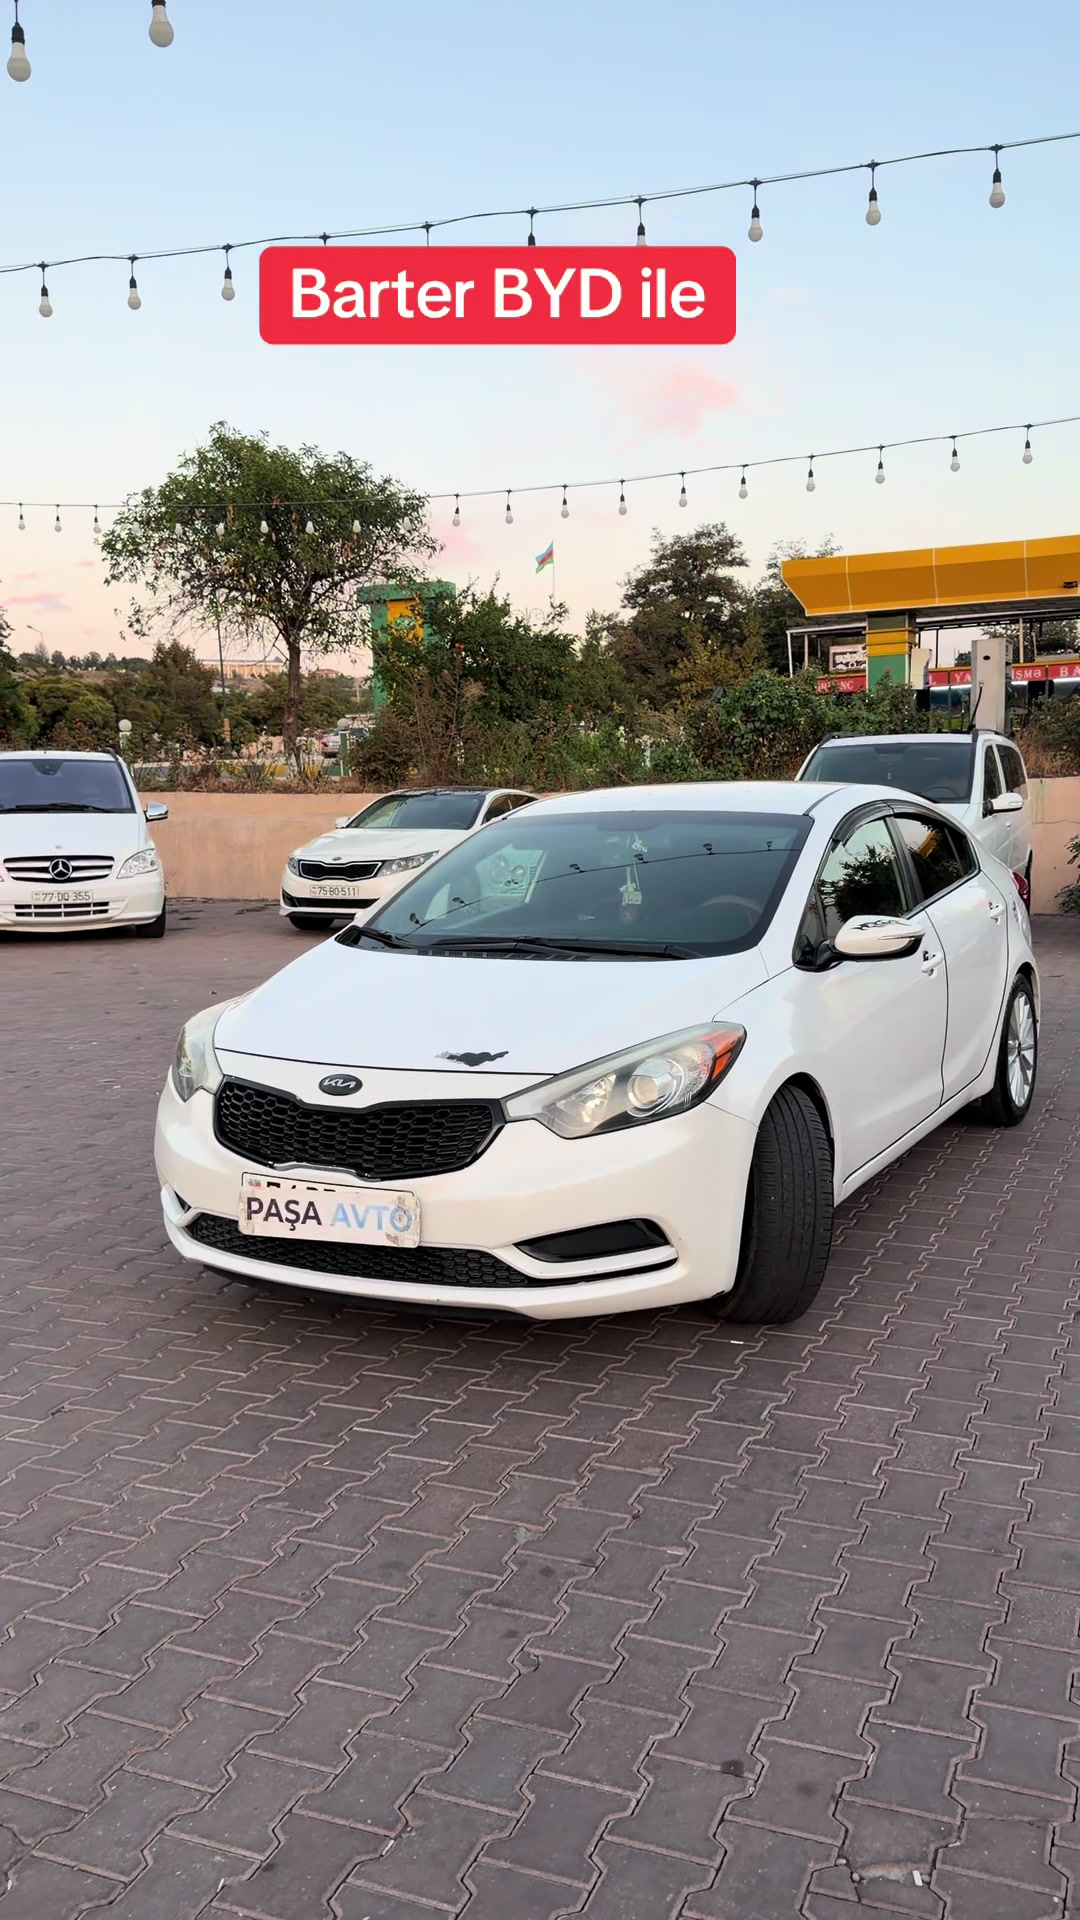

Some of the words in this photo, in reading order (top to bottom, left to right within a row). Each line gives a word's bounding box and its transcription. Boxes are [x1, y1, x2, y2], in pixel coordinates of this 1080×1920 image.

[954, 671, 972, 683] YA
[1059, 665, 1080, 677] BA
[322, 1077, 357, 1089] KIA
[246, 1196, 323, 1232] PAŞA
[330, 1202, 414, 1233] AVTO
